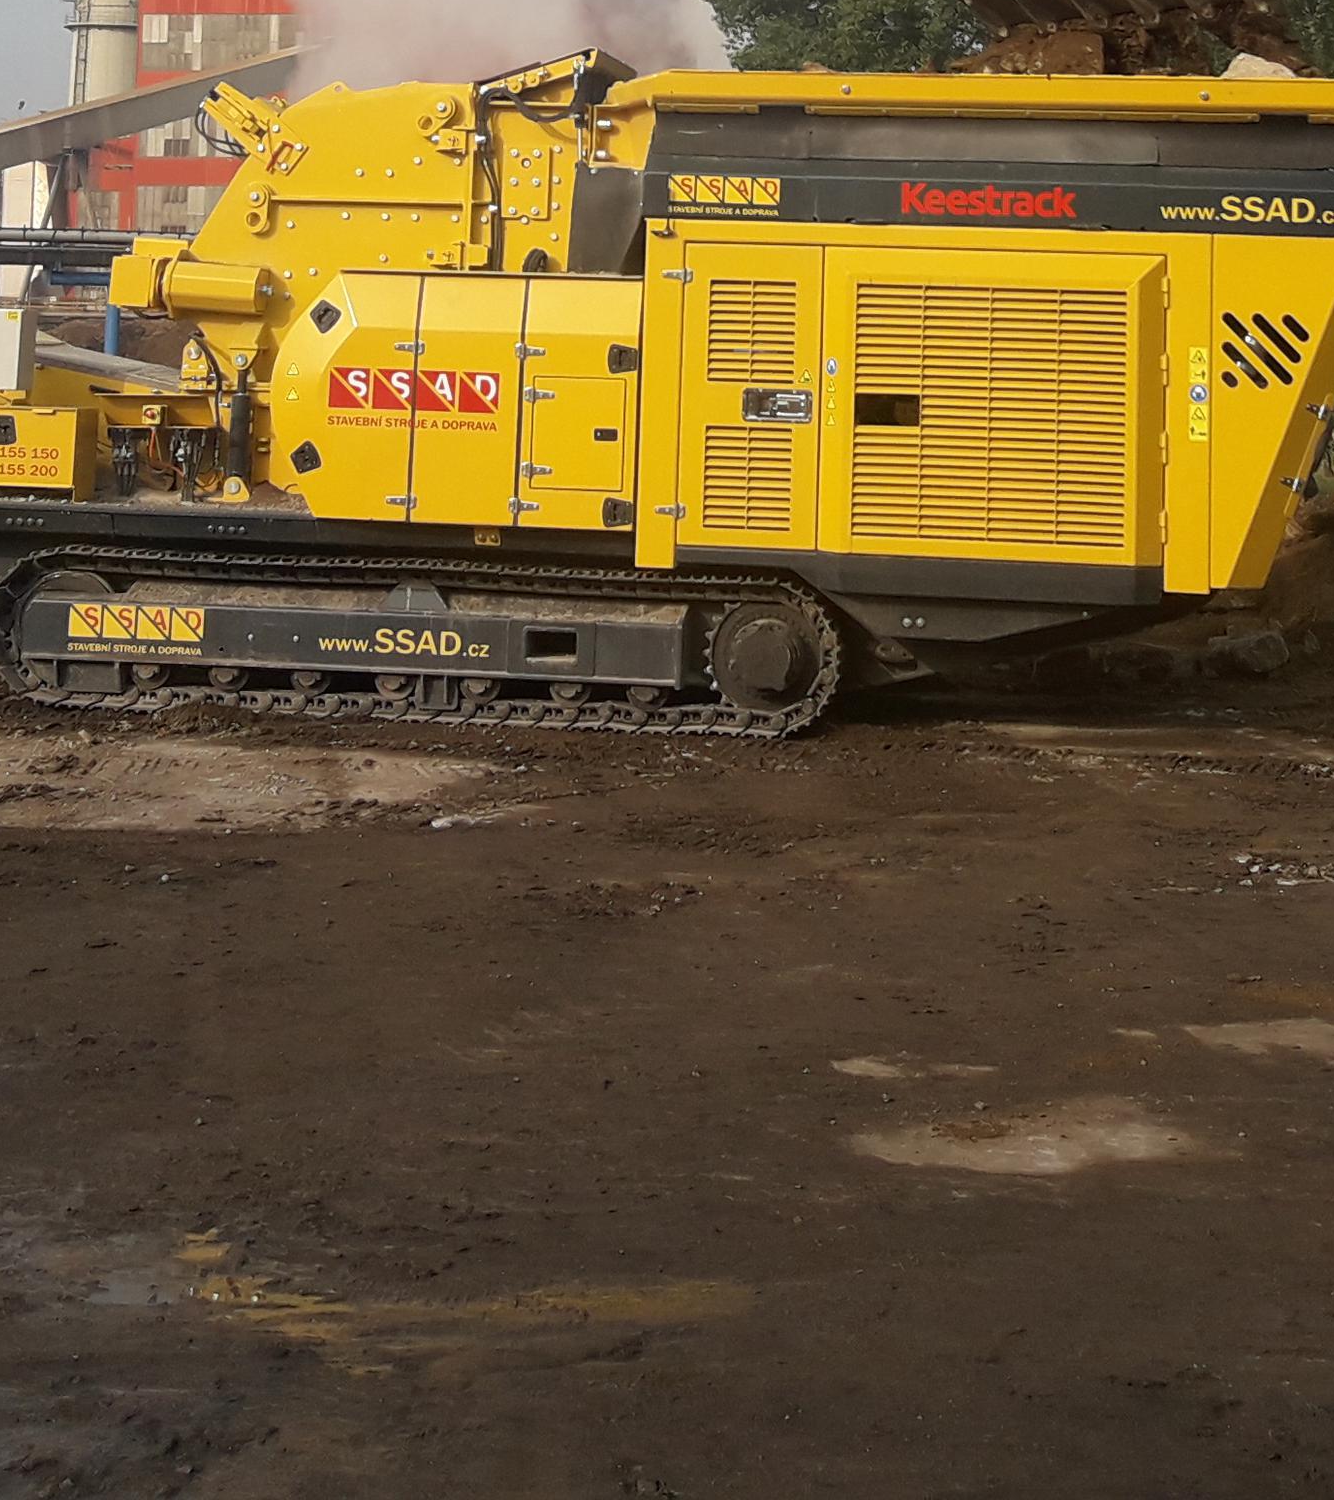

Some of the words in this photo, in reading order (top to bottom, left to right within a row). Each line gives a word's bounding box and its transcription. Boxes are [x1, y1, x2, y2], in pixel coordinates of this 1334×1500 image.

[901, 182, 1077, 218] Keestrack
[327, 415, 382, 427] STAVEBNÍ
[430, 420, 439, 429] A
[442, 420, 498, 432] DOPRAVA
[31, 448, 59, 460] 150
[30, 465, 58, 477] 200
[67, 642, 112, 652] STAVEBNÍ
[113, 644, 147, 654] STROJE
[149, 645, 156, 654] A
[158, 646, 203, 656] DOPRAVA
[318, 627, 490, 658] www.SSAD.cz
